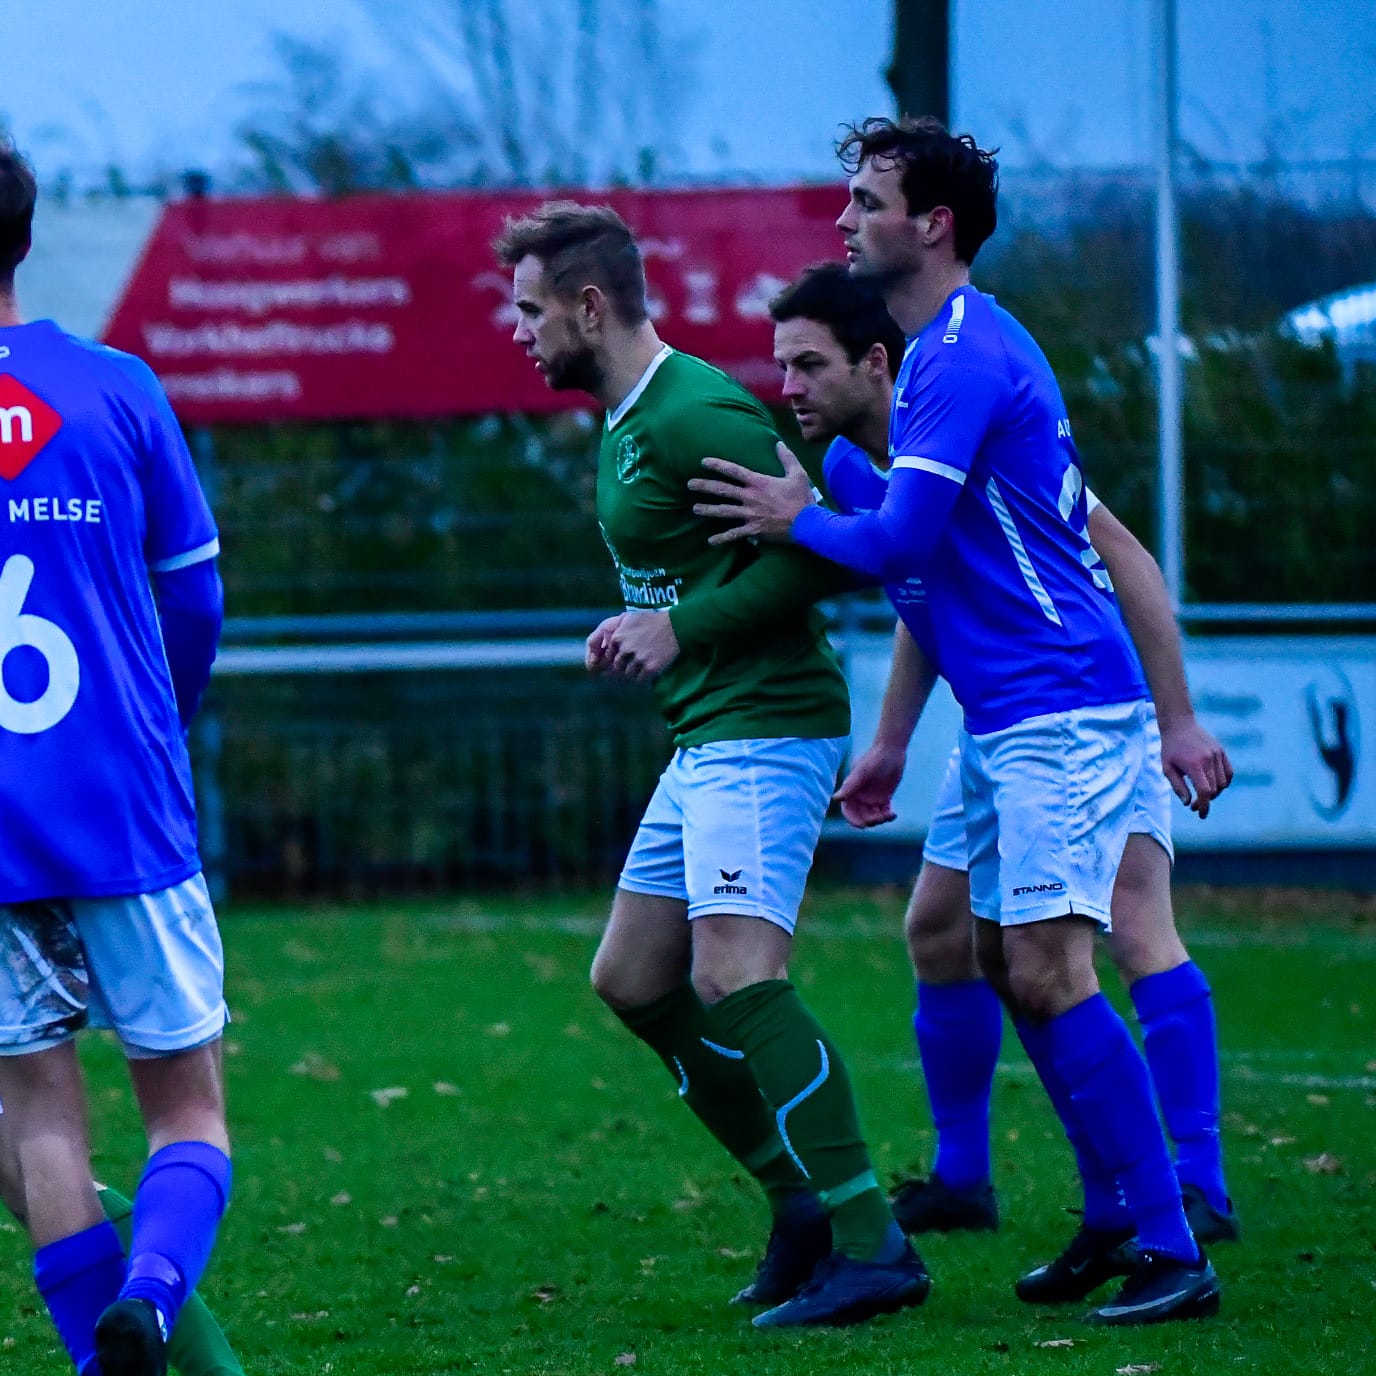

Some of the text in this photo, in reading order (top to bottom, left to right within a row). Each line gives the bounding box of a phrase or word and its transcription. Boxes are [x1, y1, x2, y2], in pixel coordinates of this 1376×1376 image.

[8, 497, 101, 523] MELSE
[713, 883, 747, 895] erima
[1012, 882, 1063, 897] STANNO
